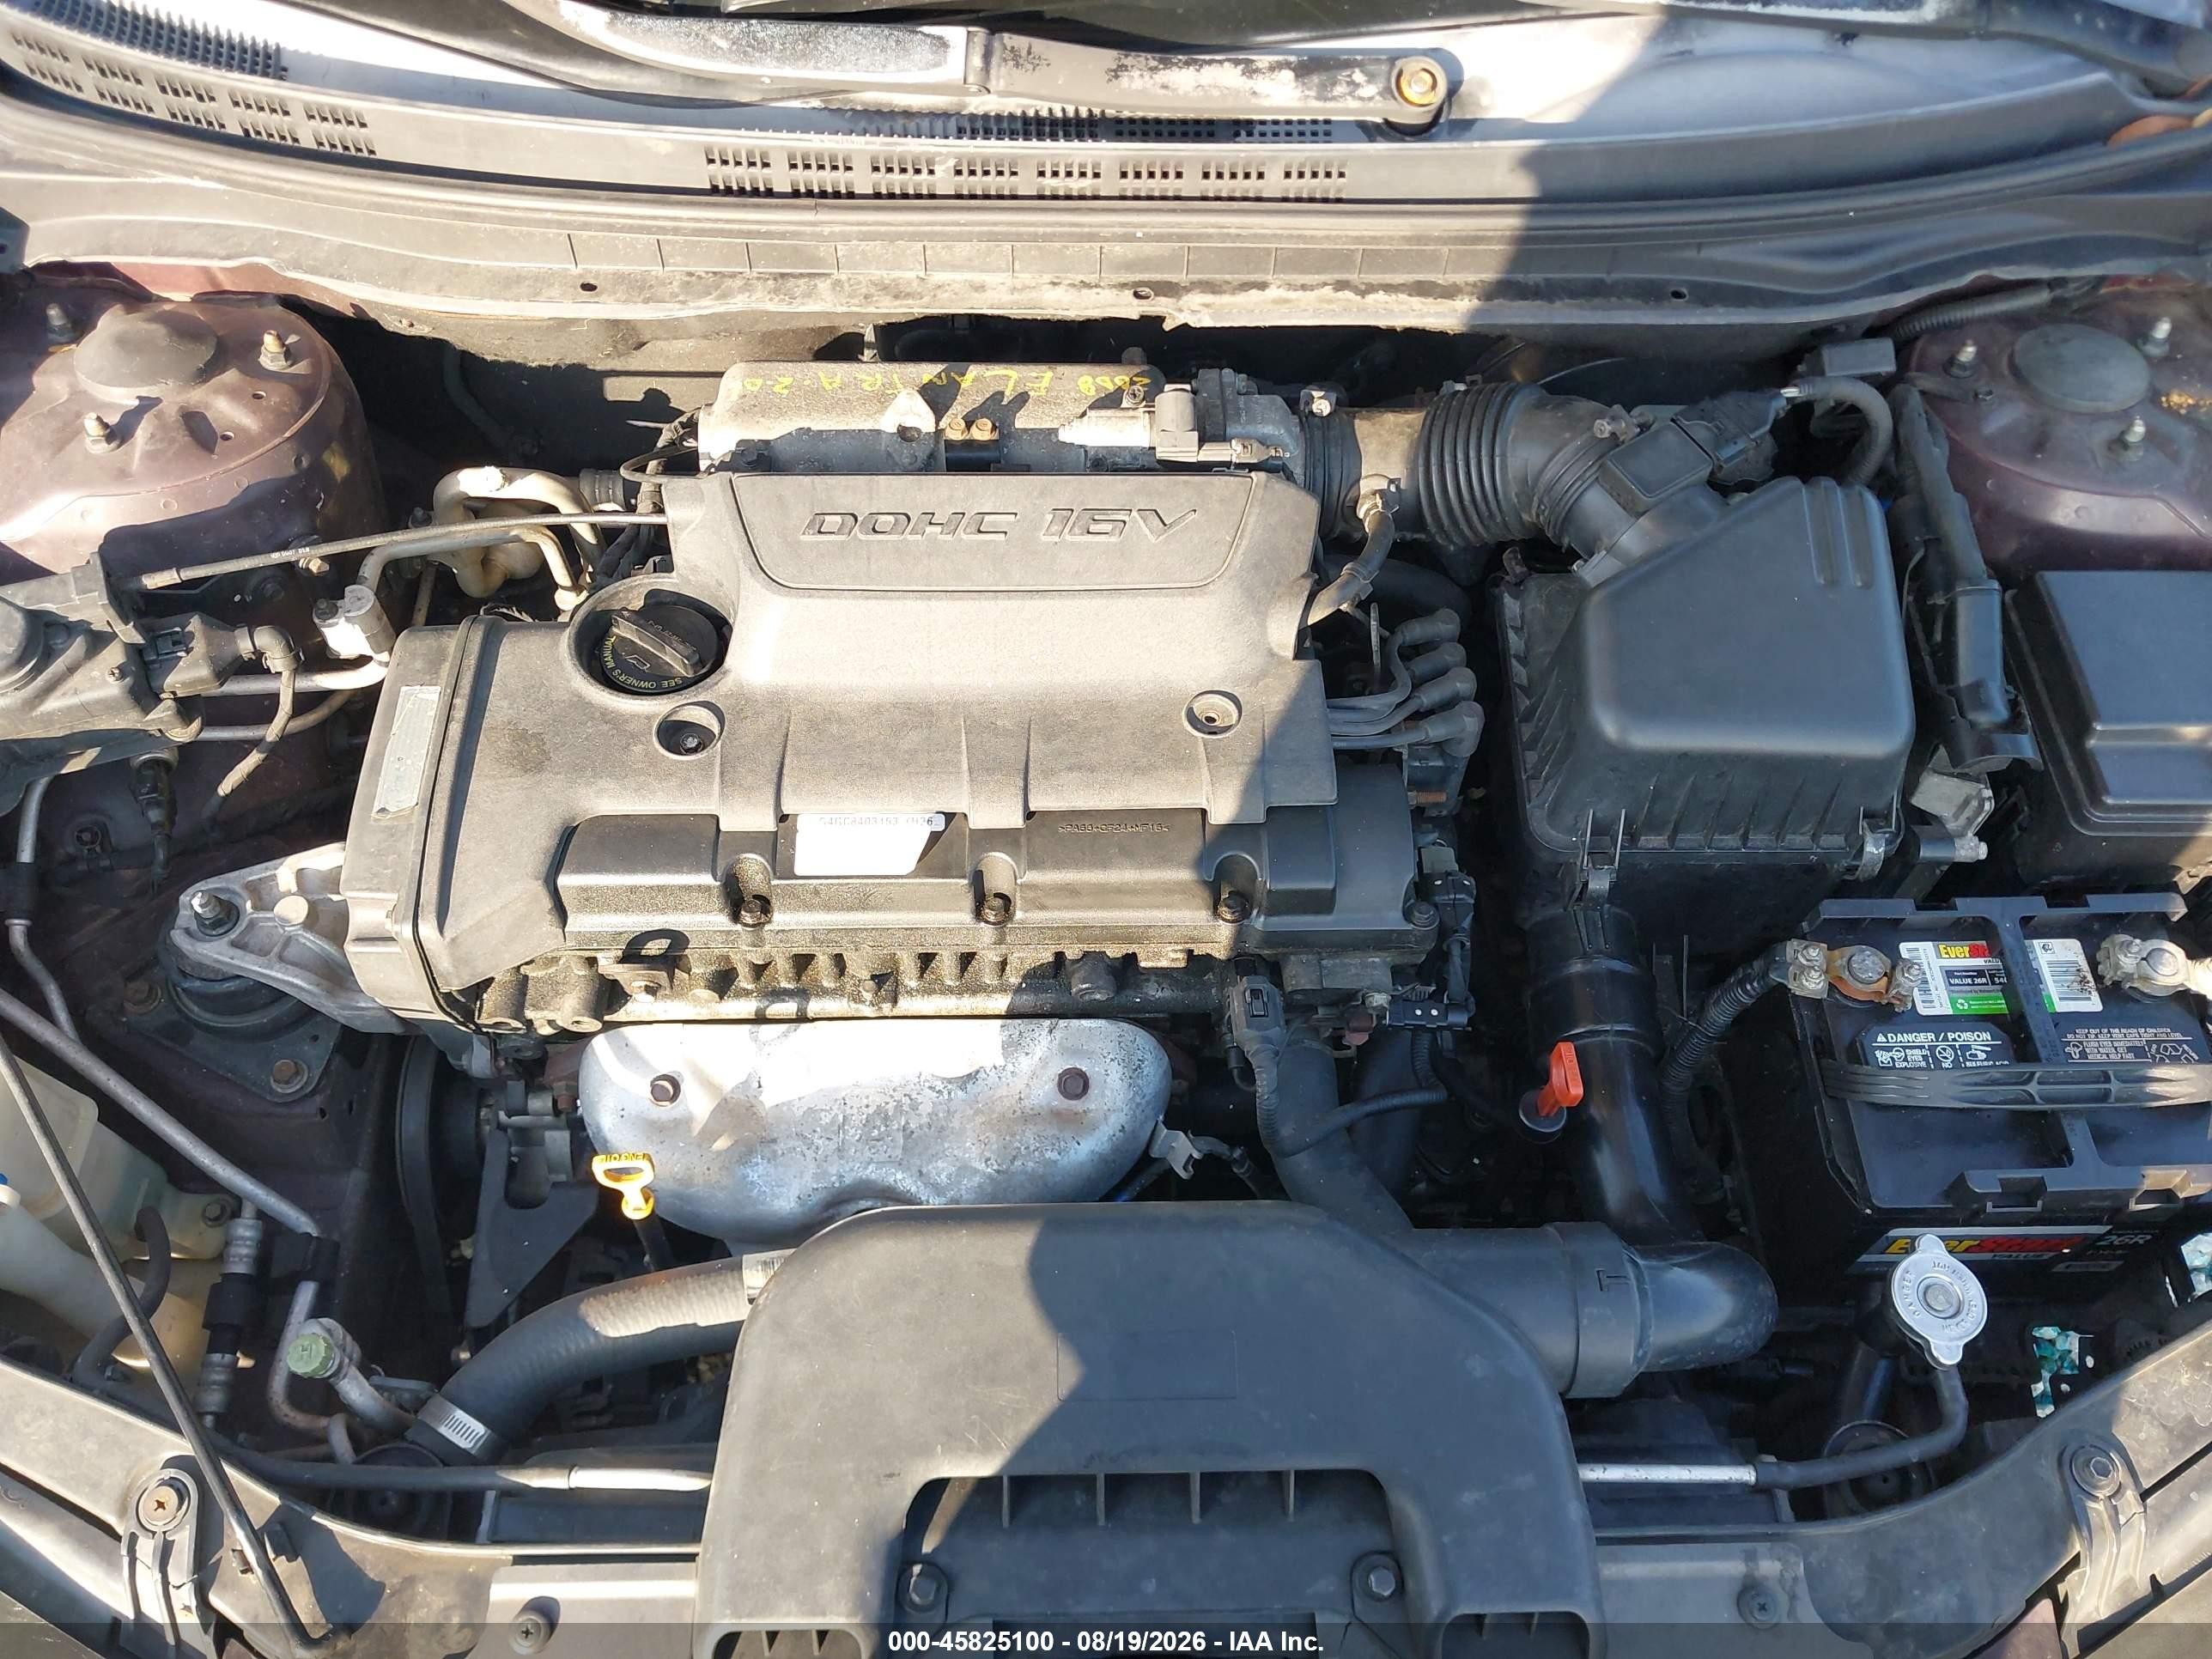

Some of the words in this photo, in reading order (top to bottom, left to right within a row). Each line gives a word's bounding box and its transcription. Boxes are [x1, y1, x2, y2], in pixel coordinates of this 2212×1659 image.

[799, 511, 1019, 540] DOHC
[1039, 508, 1197, 543] 16V
[603, 635, 617, 668] MANUAL
[612, 669, 657, 689] OWNER'S
[660, 677, 683, 688] SEE
[1887, 1032, 1936, 1042] DANGER
[1948, 1031, 1991, 1042] POISON
[2095, 1235, 2152, 1245] 26R
